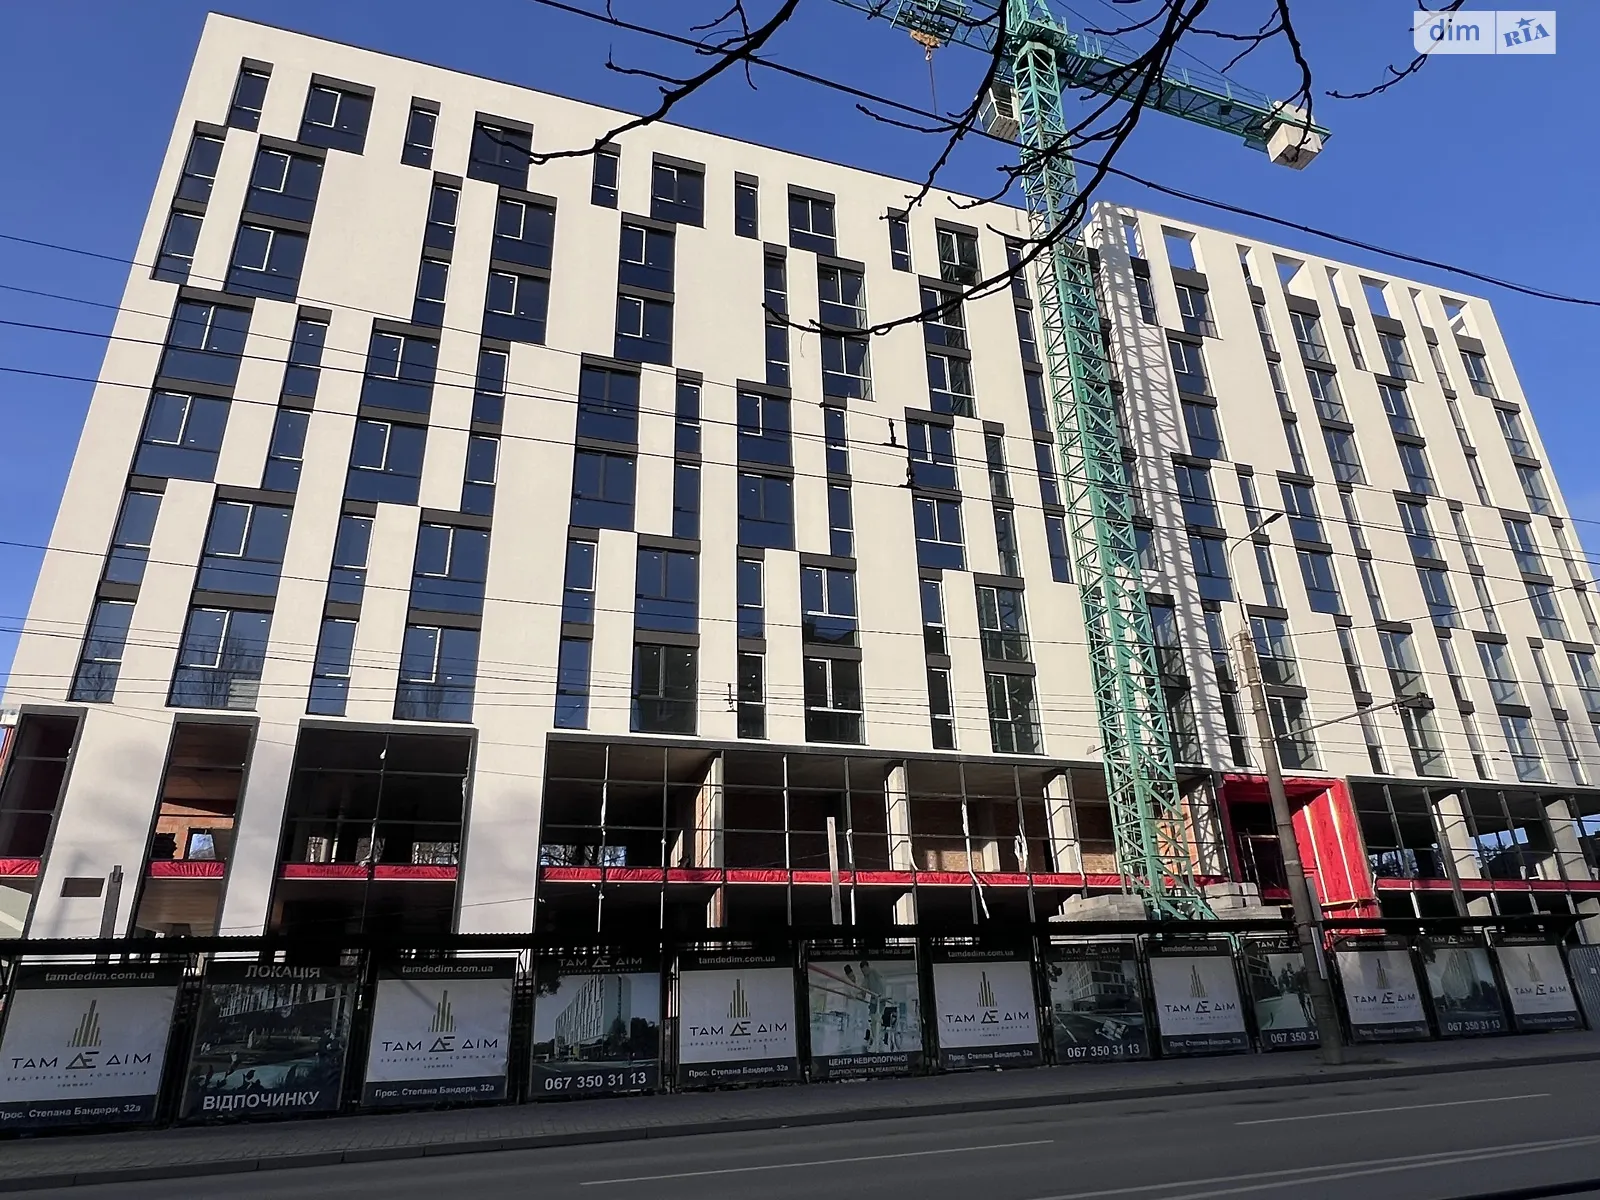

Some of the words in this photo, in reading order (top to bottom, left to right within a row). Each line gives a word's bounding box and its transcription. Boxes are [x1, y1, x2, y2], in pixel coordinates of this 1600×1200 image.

[558, 957, 588, 967] ТАМ
[698, 955, 776, 964] tamdedim.com.ua
[245, 965, 321, 980] ЛОКАЦІЯ
[402, 964, 494, 973] tamdedim.com.ua
[45, 971, 155, 982] tamdedim.com.ua
[1353, 995, 1377, 1003] ТАМ
[1164, 1004, 1191, 1013] ТАМ
[945, 1014, 976, 1023] ТАМ
[689, 1026, 724, 1036] ТАМ
[1447, 1022, 1463, 1032] 067
[1465, 1021, 1479, 1031] 350
[1480, 1020, 1490, 1030] 31
[1491, 1019, 1501, 1029] 13
[1270, 1032, 1287, 1044] 067
[1290, 1031, 1306, 1043] 350
[1308, 1030, 1320, 1041] 31
[382, 1041, 422, 1052] ТАМ
[1067, 1046, 1087, 1058] 067
[1091, 1045, 1109, 1057] 350
[1112, 1044, 1124, 1055] 31
[1128, 1043, 1140, 1054] 13
[12, 1057, 58, 1069] ТАМ
[828, 1058, 853, 1067] ЦЕНТР
[711, 1067, 742, 1076] Степана
[544, 1076, 572, 1091] 067
[576, 1074, 604, 1089] 350
[607, 1072, 624, 1086] 31
[629, 1071, 647, 1084] 13
[375, 1088, 399, 1099] Прос.
[401, 1087, 438, 1097] Степана
[480, 1083, 495, 1092] 32а
[202, 1091, 321, 1112] ВІДПОЧИНКУ
[29, 1107, 72, 1118] Степана
[123, 1104, 141, 1113] 32а
